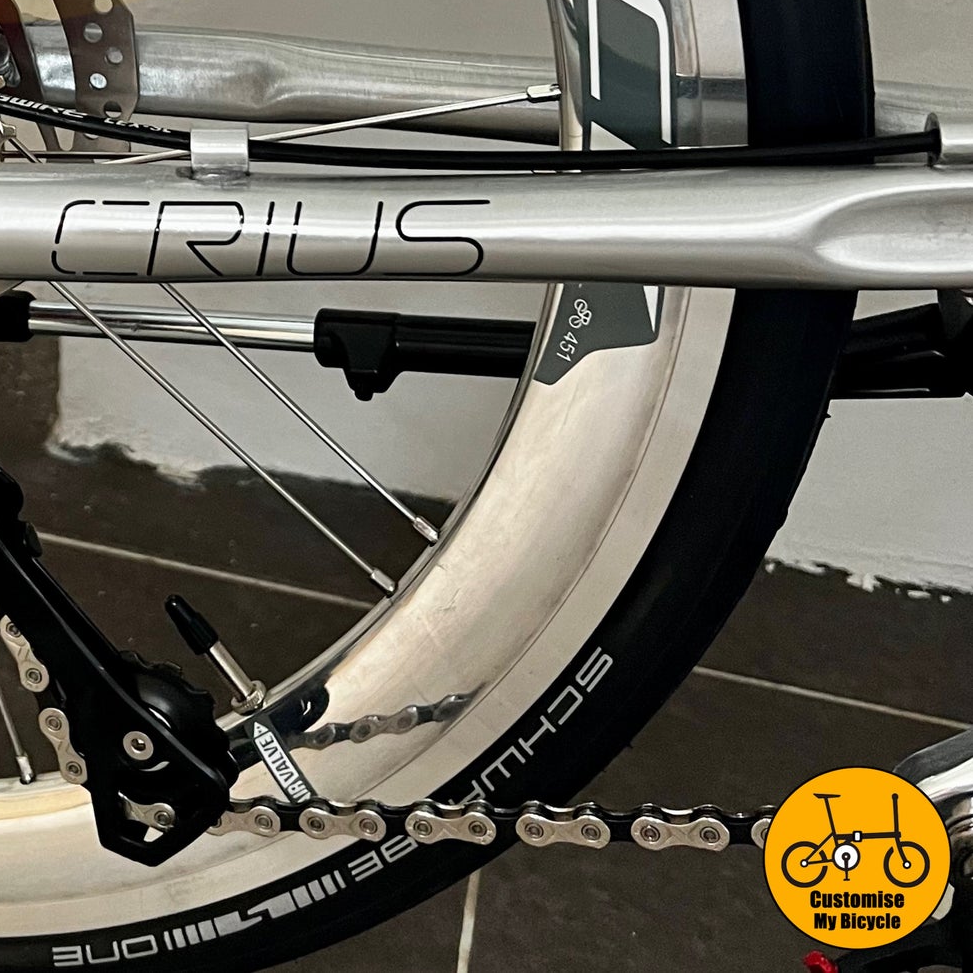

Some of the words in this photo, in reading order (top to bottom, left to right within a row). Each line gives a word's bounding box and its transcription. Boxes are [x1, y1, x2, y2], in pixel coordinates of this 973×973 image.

[51, 200, 490, 277] CRIUS
[556, 331, 579, 362] 451
[52, 934, 159, 967] ONE
